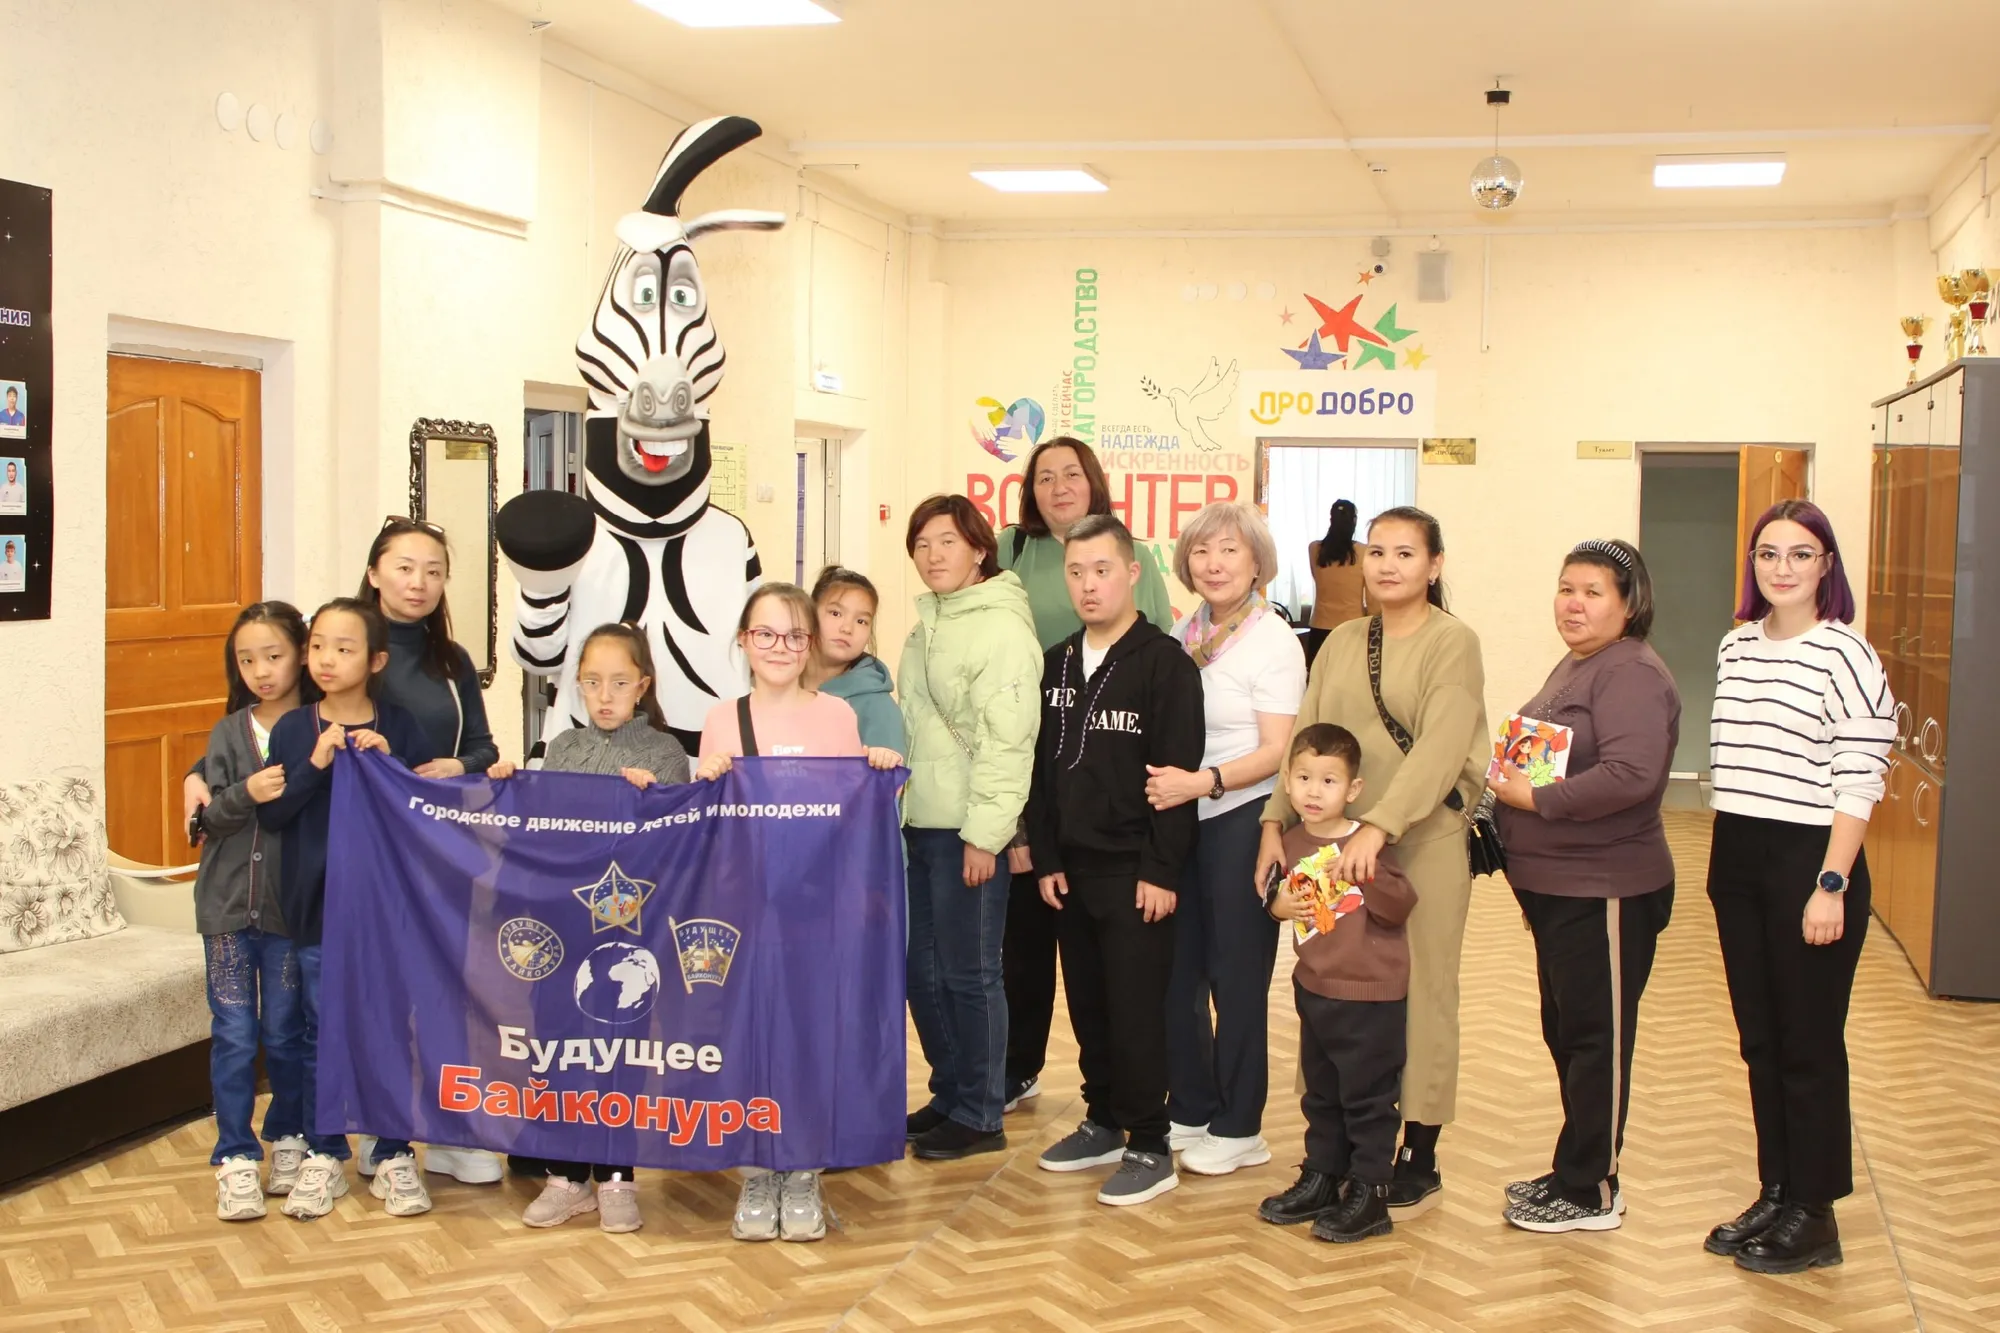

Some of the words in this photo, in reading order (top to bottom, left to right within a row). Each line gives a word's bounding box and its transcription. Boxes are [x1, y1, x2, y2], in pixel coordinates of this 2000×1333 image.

[1073, 268, 1099, 447] АГОРОДСТВО
[1060, 370, 1073, 416] СЕЙЧАС
[1101, 425, 1131, 434] ВСЕГДА
[1133, 425, 1152, 433] ЕСТЬ
[1101, 434, 1180, 451] НАДЕЖДА
[967, 474, 1238, 539] ВОНТЕР
[1089, 709, 1142, 734] SAME.
[408, 796, 521, 828] Городское
[525, 816, 637, 834] движение
[638, 808, 701, 833] детей
[498, 1024, 723, 1075] Будущее
[439, 1063, 782, 1147] Байконура
